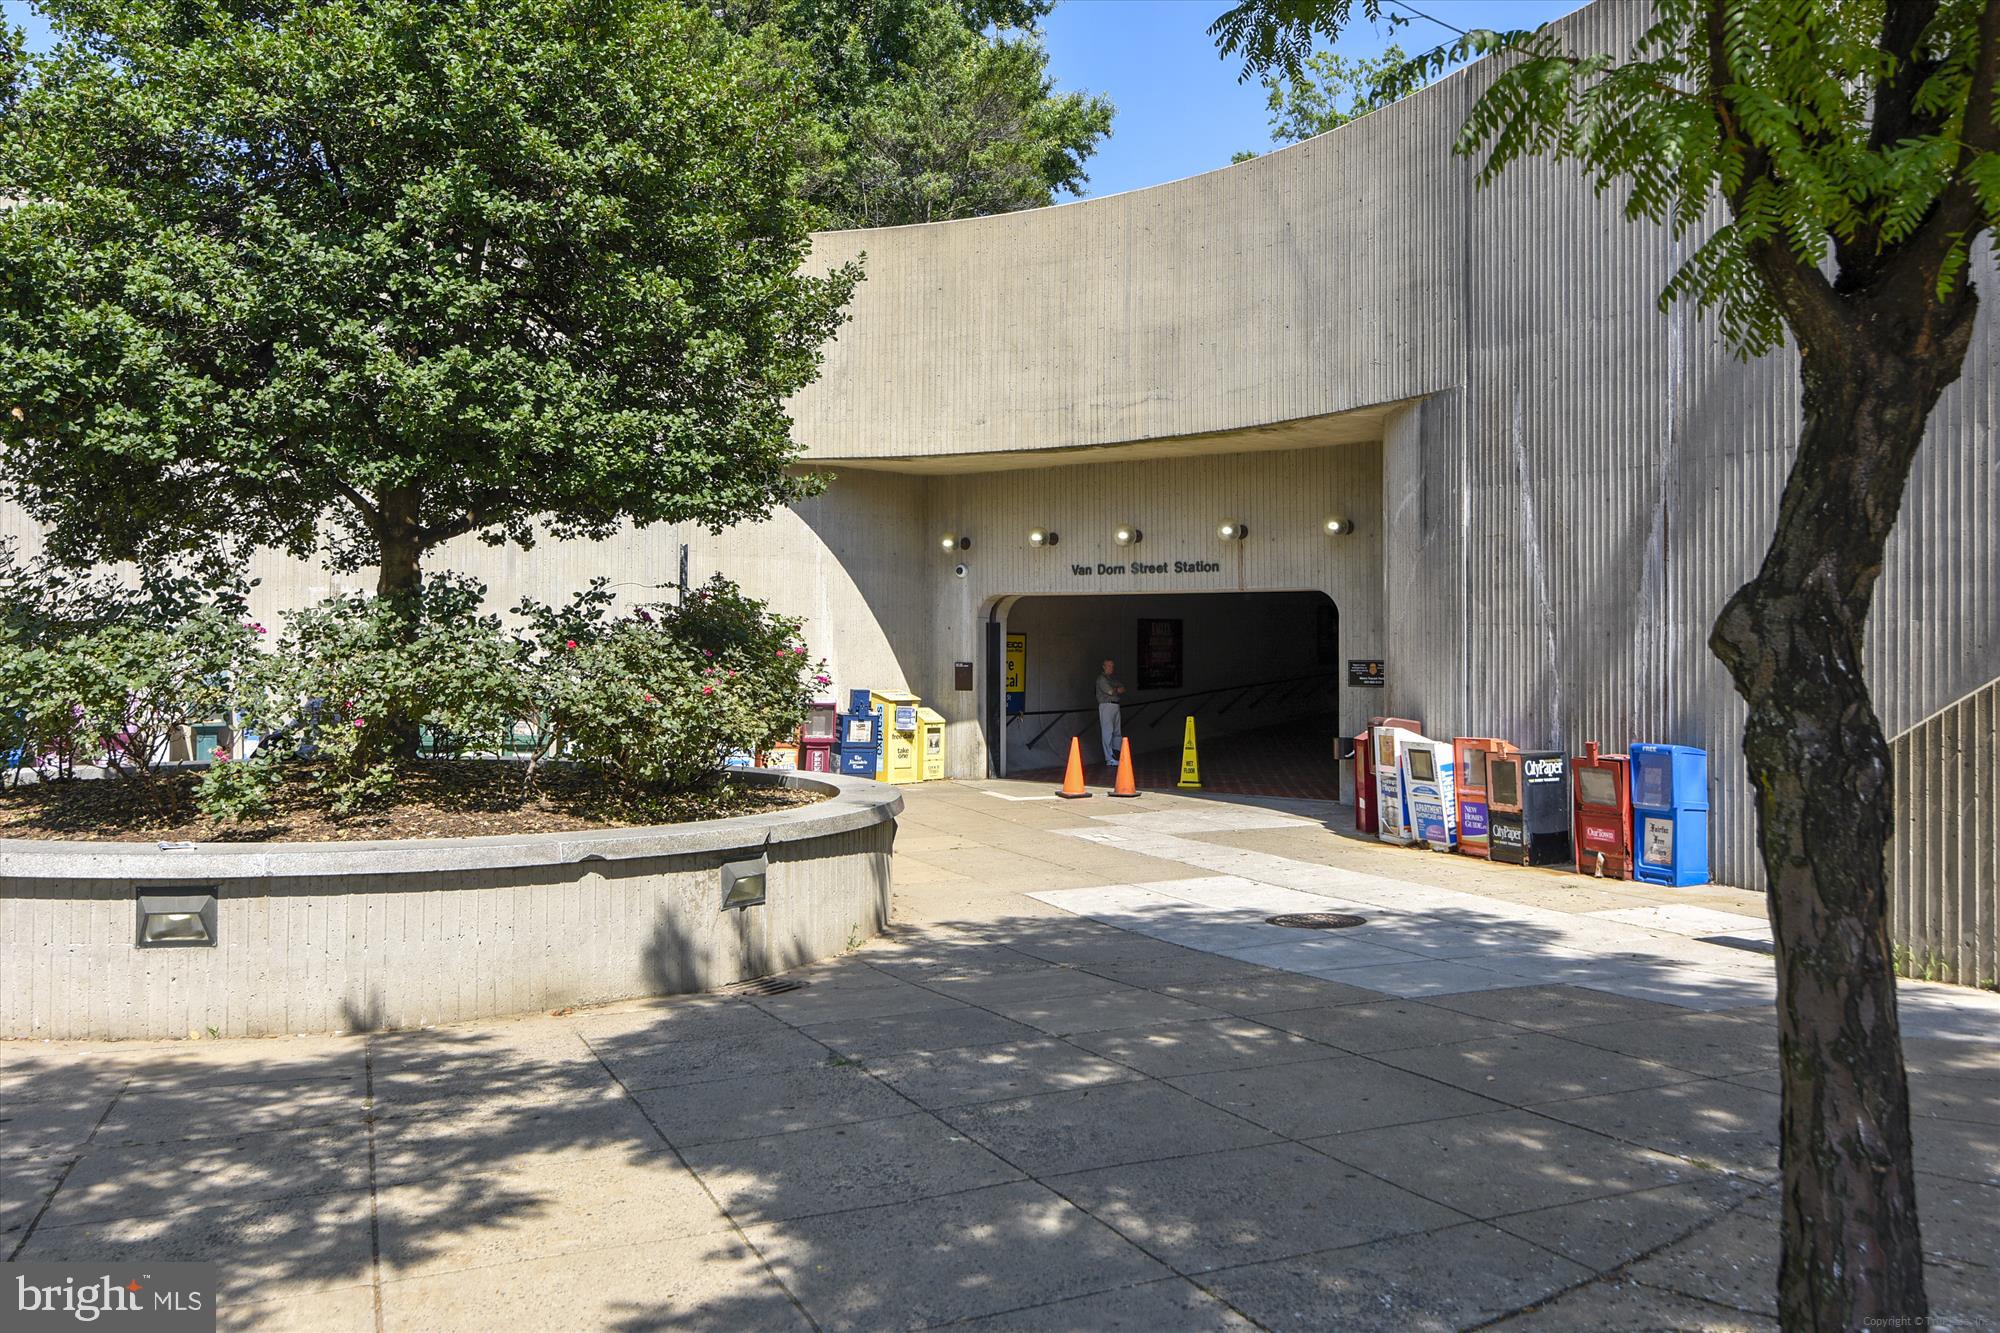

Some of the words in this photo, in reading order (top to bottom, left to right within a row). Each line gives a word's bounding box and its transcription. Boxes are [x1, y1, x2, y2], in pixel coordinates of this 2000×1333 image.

[1071, 564, 1092, 576] Van
[1097, 563, 1126, 576] Dorn
[1130, 561, 1169, 575] Street
[1174, 560, 1220, 573] Station
[1525, 759, 1563, 778] CityPaper
[1464, 805, 1478, 814] NEW
[1464, 812, 1484, 822] HOMES
[1492, 824, 1522, 841] CityPaper
